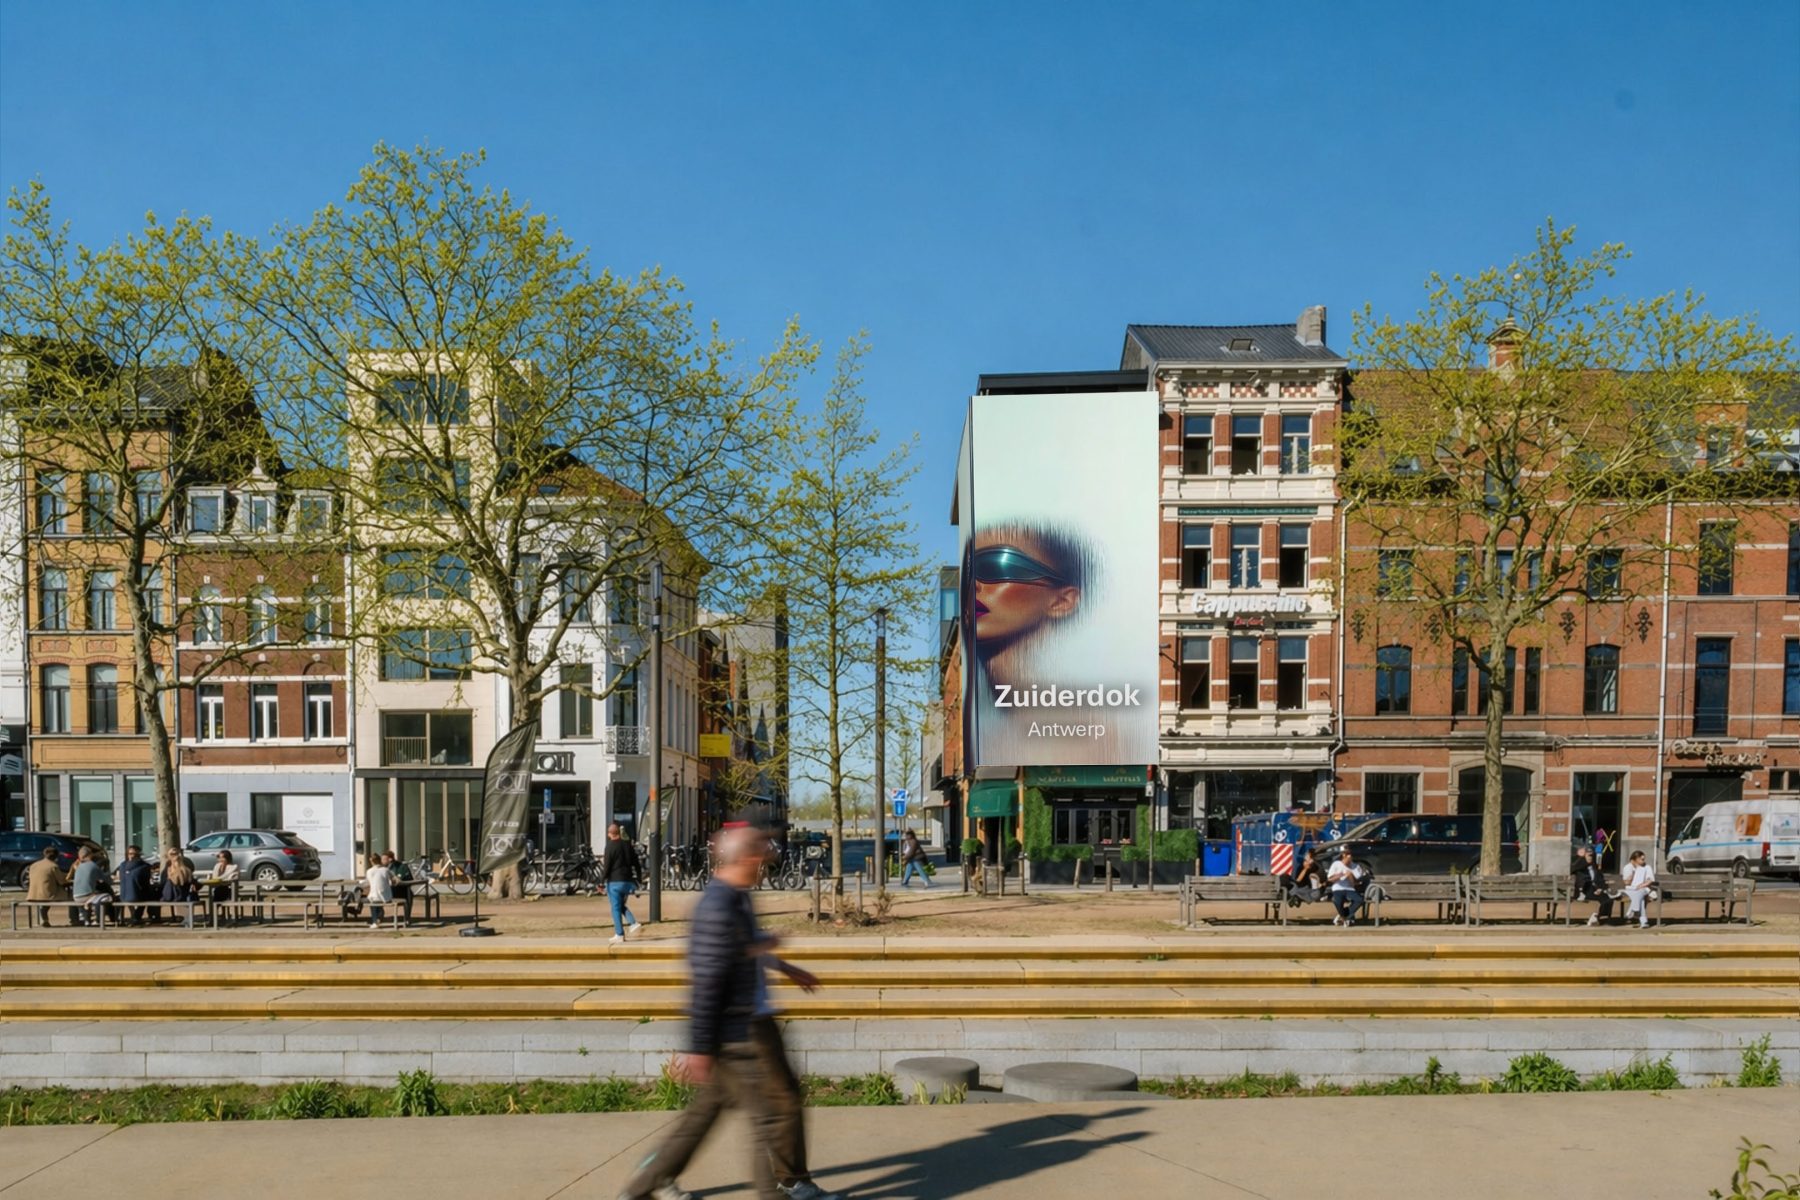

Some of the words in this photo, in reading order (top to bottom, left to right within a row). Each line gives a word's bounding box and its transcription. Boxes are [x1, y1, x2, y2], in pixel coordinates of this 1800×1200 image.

[1191, 592, 1307, 618] Cappuccino
[994, 683, 1141, 708] Zuiderdok
[1027, 721, 1106, 740] Antwerp
